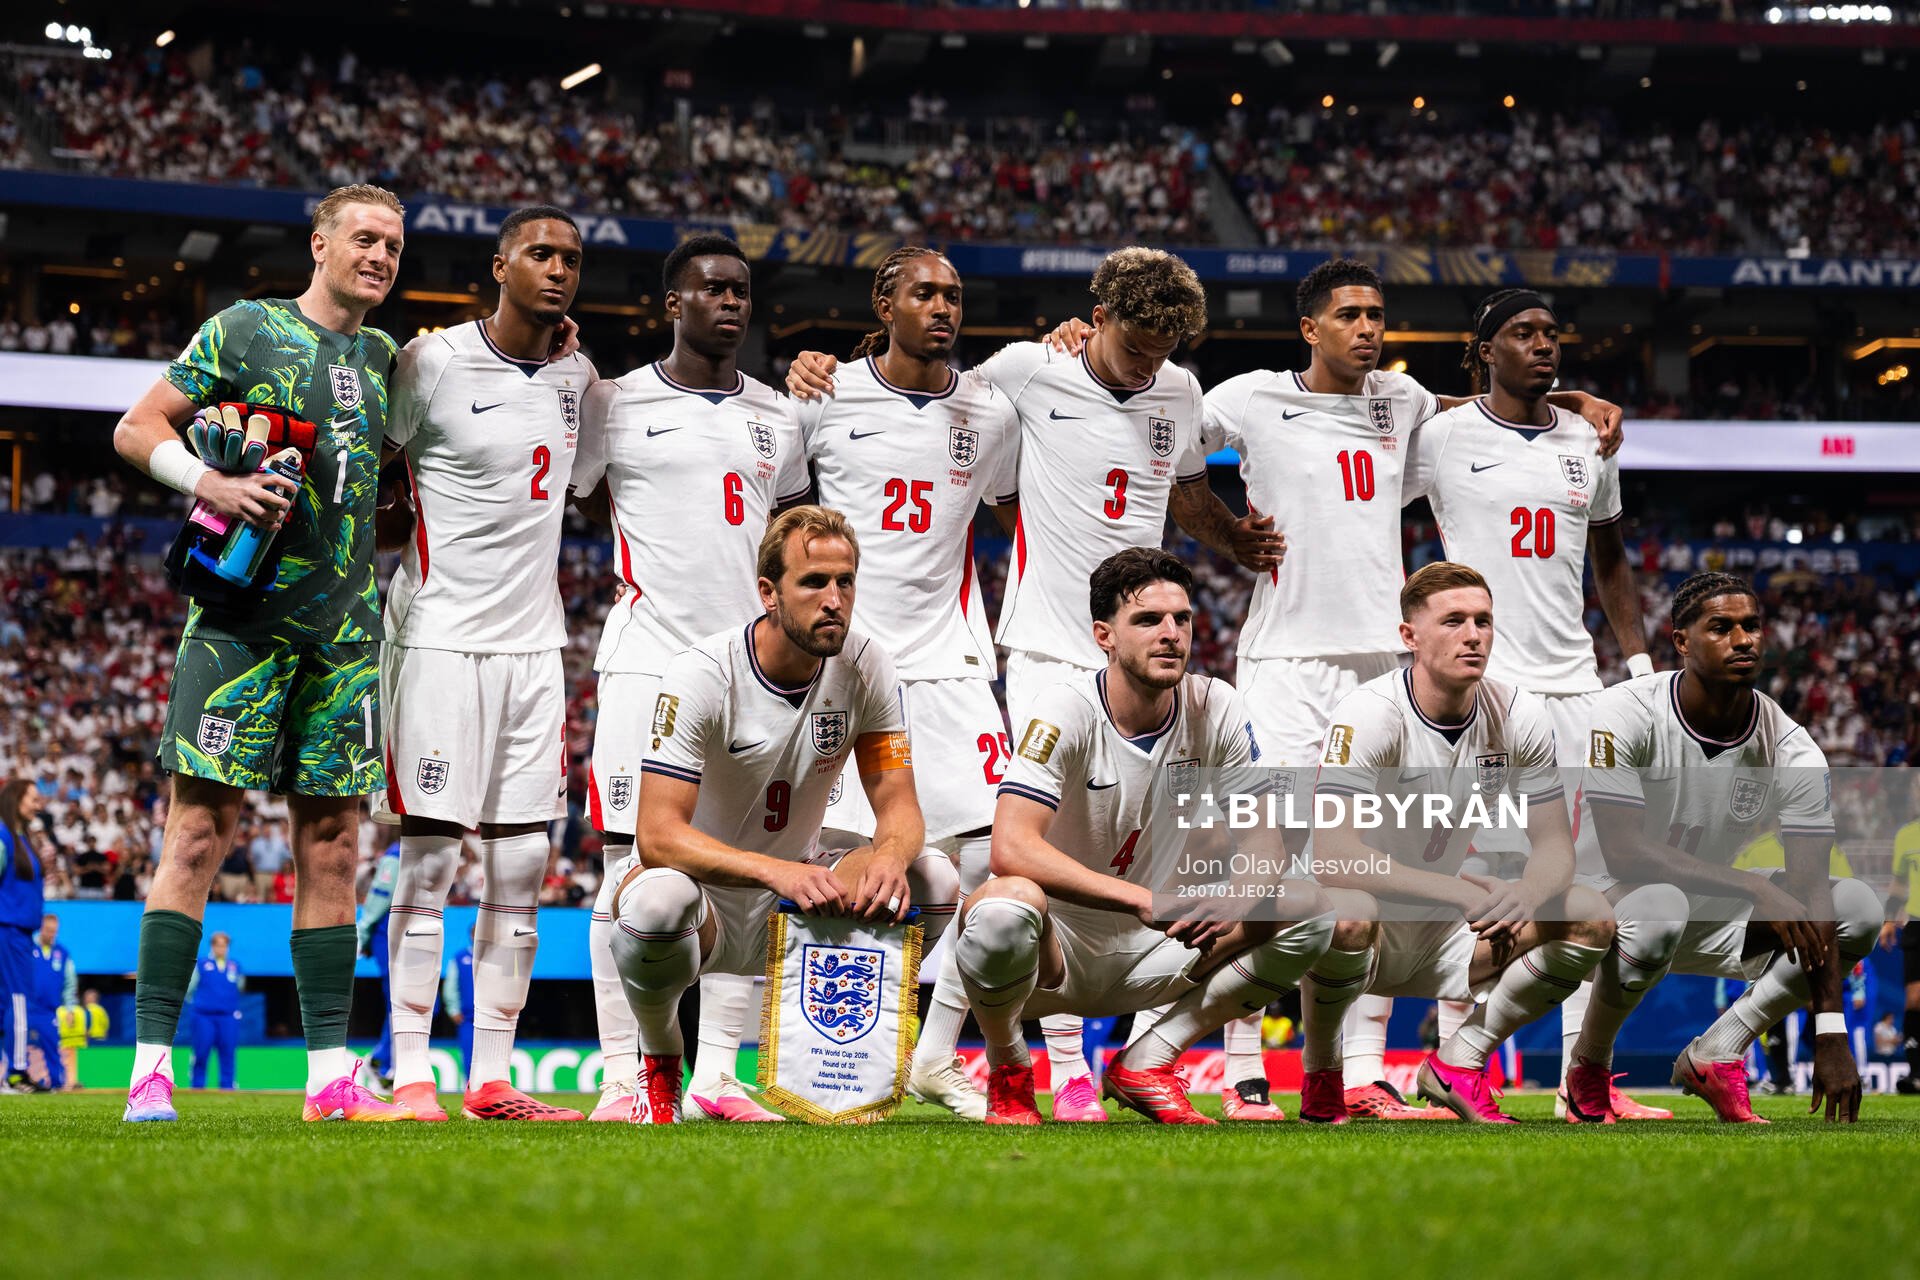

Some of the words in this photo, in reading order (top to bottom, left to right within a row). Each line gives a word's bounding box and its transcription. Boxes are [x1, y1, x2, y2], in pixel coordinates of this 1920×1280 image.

[333, 449, 348, 504] 1
[530, 445, 551, 501] 2
[723, 471, 745, 526] 6
[1103, 467, 1129, 520] 3
[1336, 449, 1375, 501] 10
[881, 477, 934, 534] 25
[1510, 506, 1556, 559] 20
[361, 694, 373, 749] 1
[764, 780, 791, 833] 9
[1109, 829, 1142, 876] 4
[1422, 817, 1456, 863] 8
[818, 1071, 836, 1079] Atlanta
[837, 1072, 859, 1080] Stadium
[822, 1060, 839, 1068] Round
[825, 1049, 840, 1057] World
[842, 1051, 853, 1059] Cup
[812, 1082, 841, 1091] Wednesday
[852, 1085, 863, 1093] July
